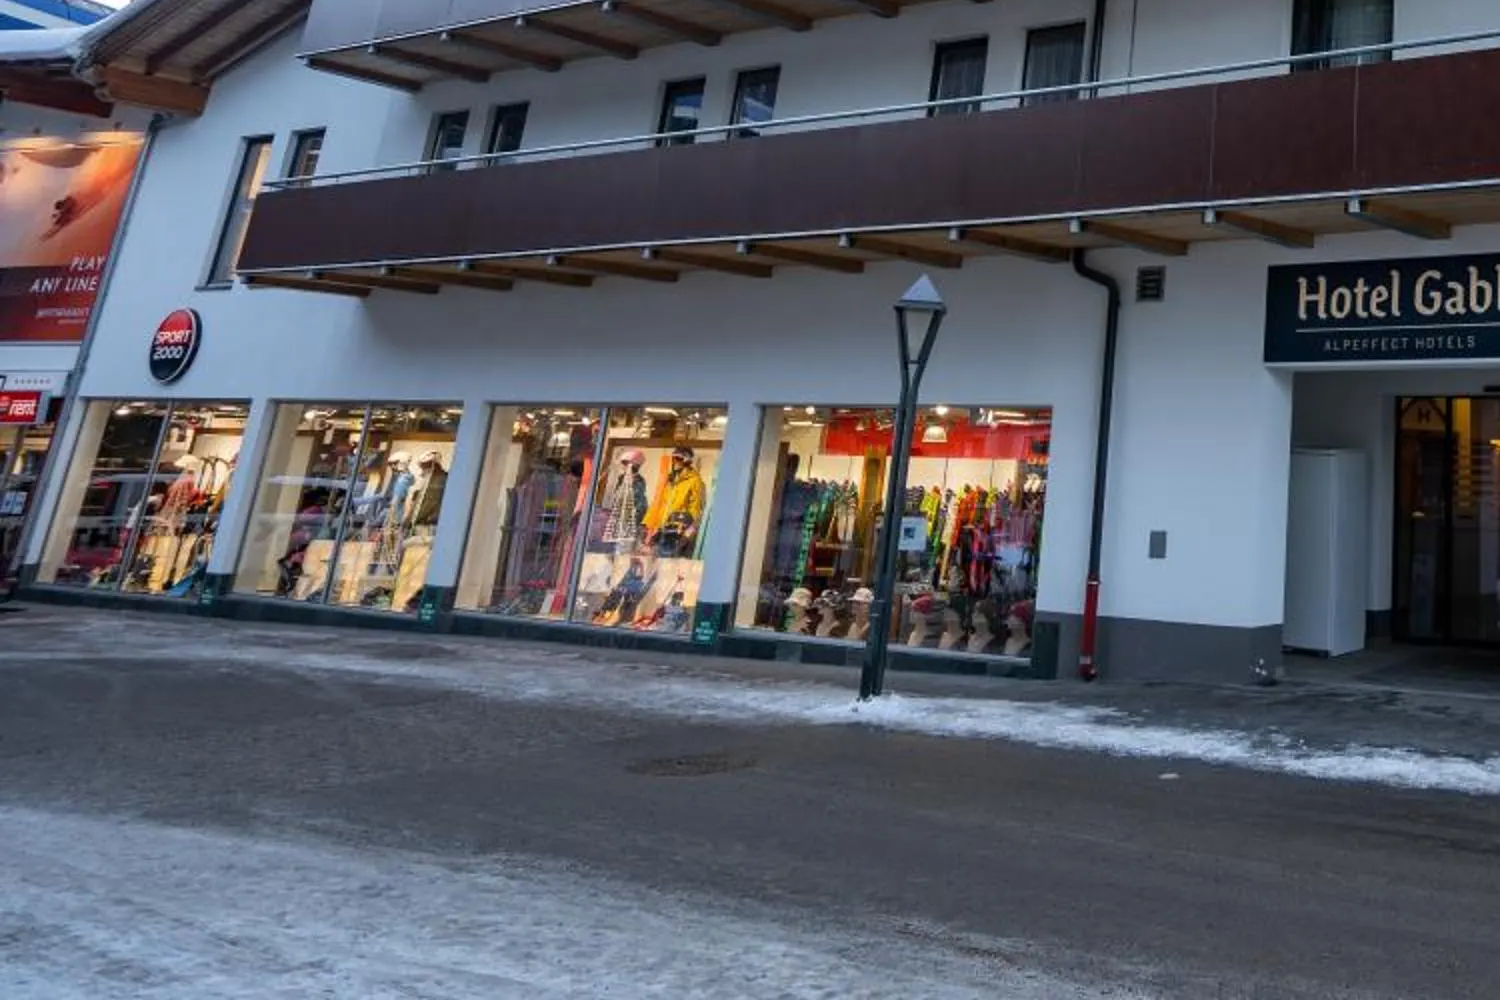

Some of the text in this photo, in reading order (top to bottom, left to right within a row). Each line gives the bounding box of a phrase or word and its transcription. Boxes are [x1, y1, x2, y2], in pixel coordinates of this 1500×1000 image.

[70, 255, 106, 272] PLAY
[29, 275, 99, 293] ANY LINE
[1297, 269, 1402, 321] Hotel
[155, 329, 192, 345] SPORT
[1323, 335, 1476, 352] ALPEFFECT HOTELS
[153, 345, 184, 361] 2000
[8, 400, 37, 417] rent
